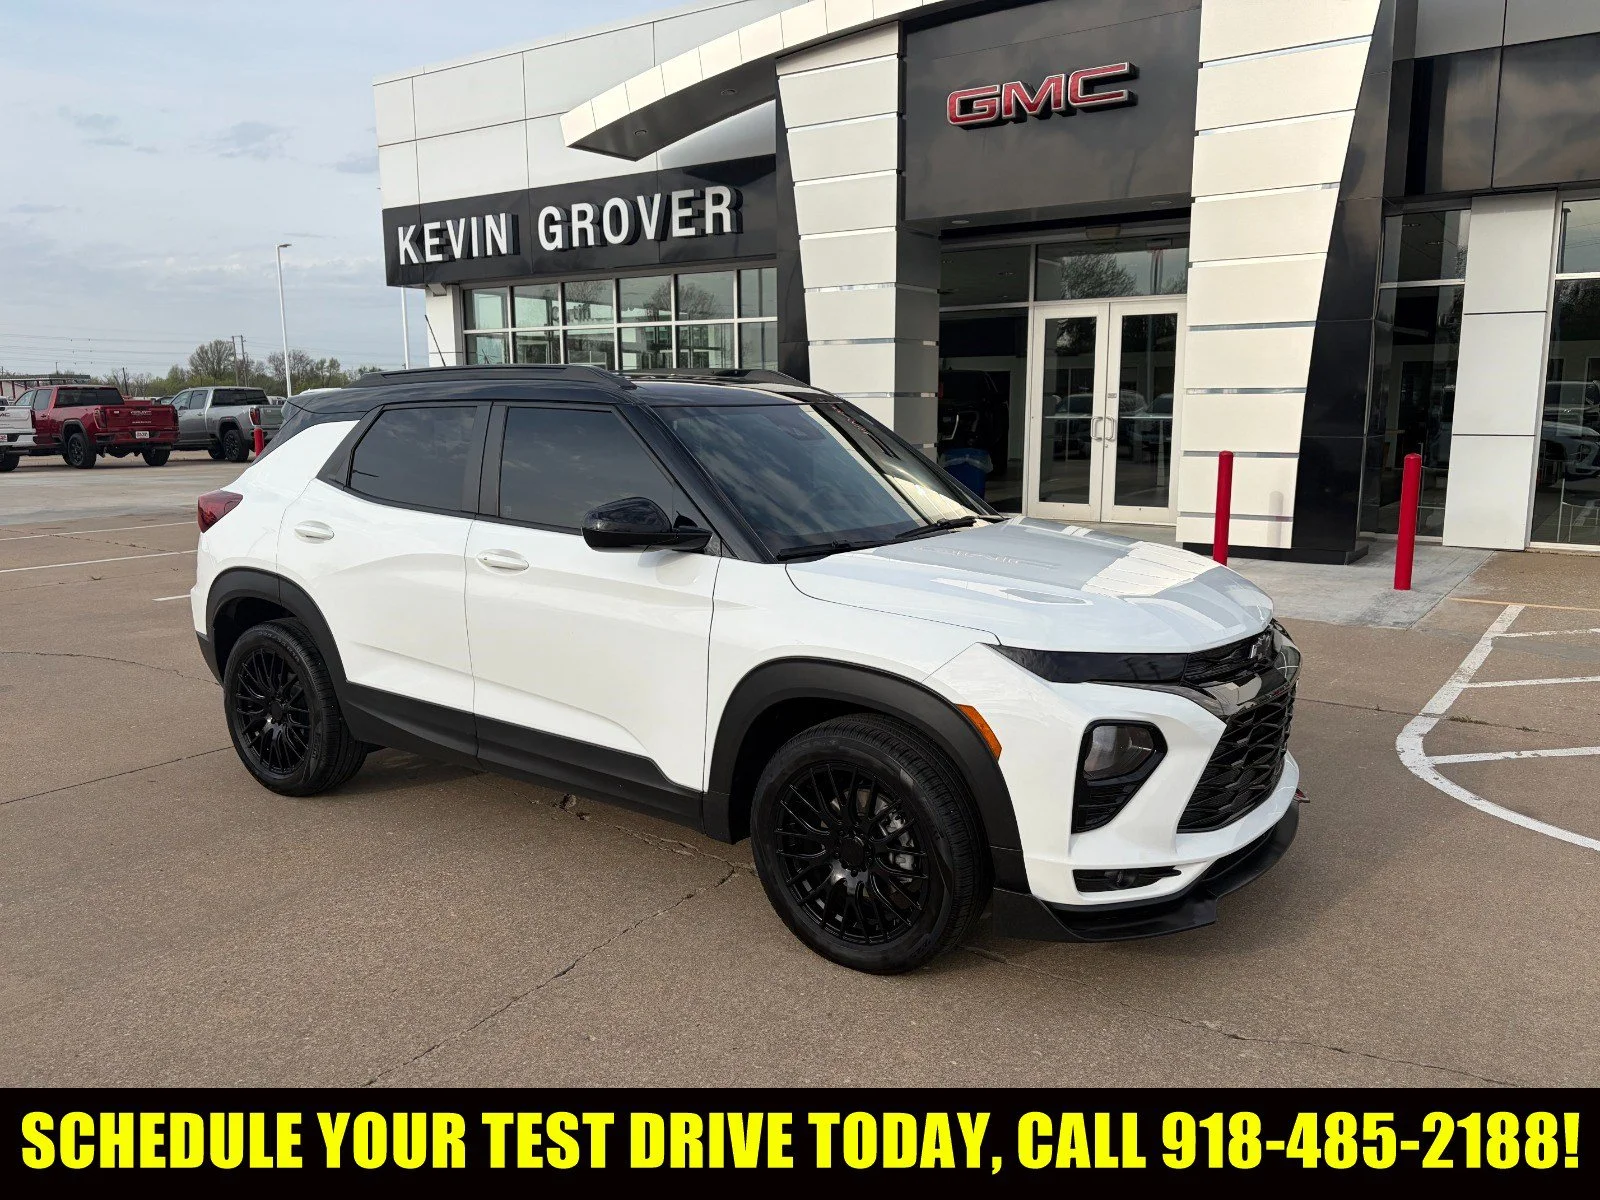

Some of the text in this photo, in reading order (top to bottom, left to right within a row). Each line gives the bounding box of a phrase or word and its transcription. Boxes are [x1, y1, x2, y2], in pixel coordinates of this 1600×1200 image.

[946, 61, 1130, 127] GMC
[397, 185, 733, 266] KEVIN GROVER
